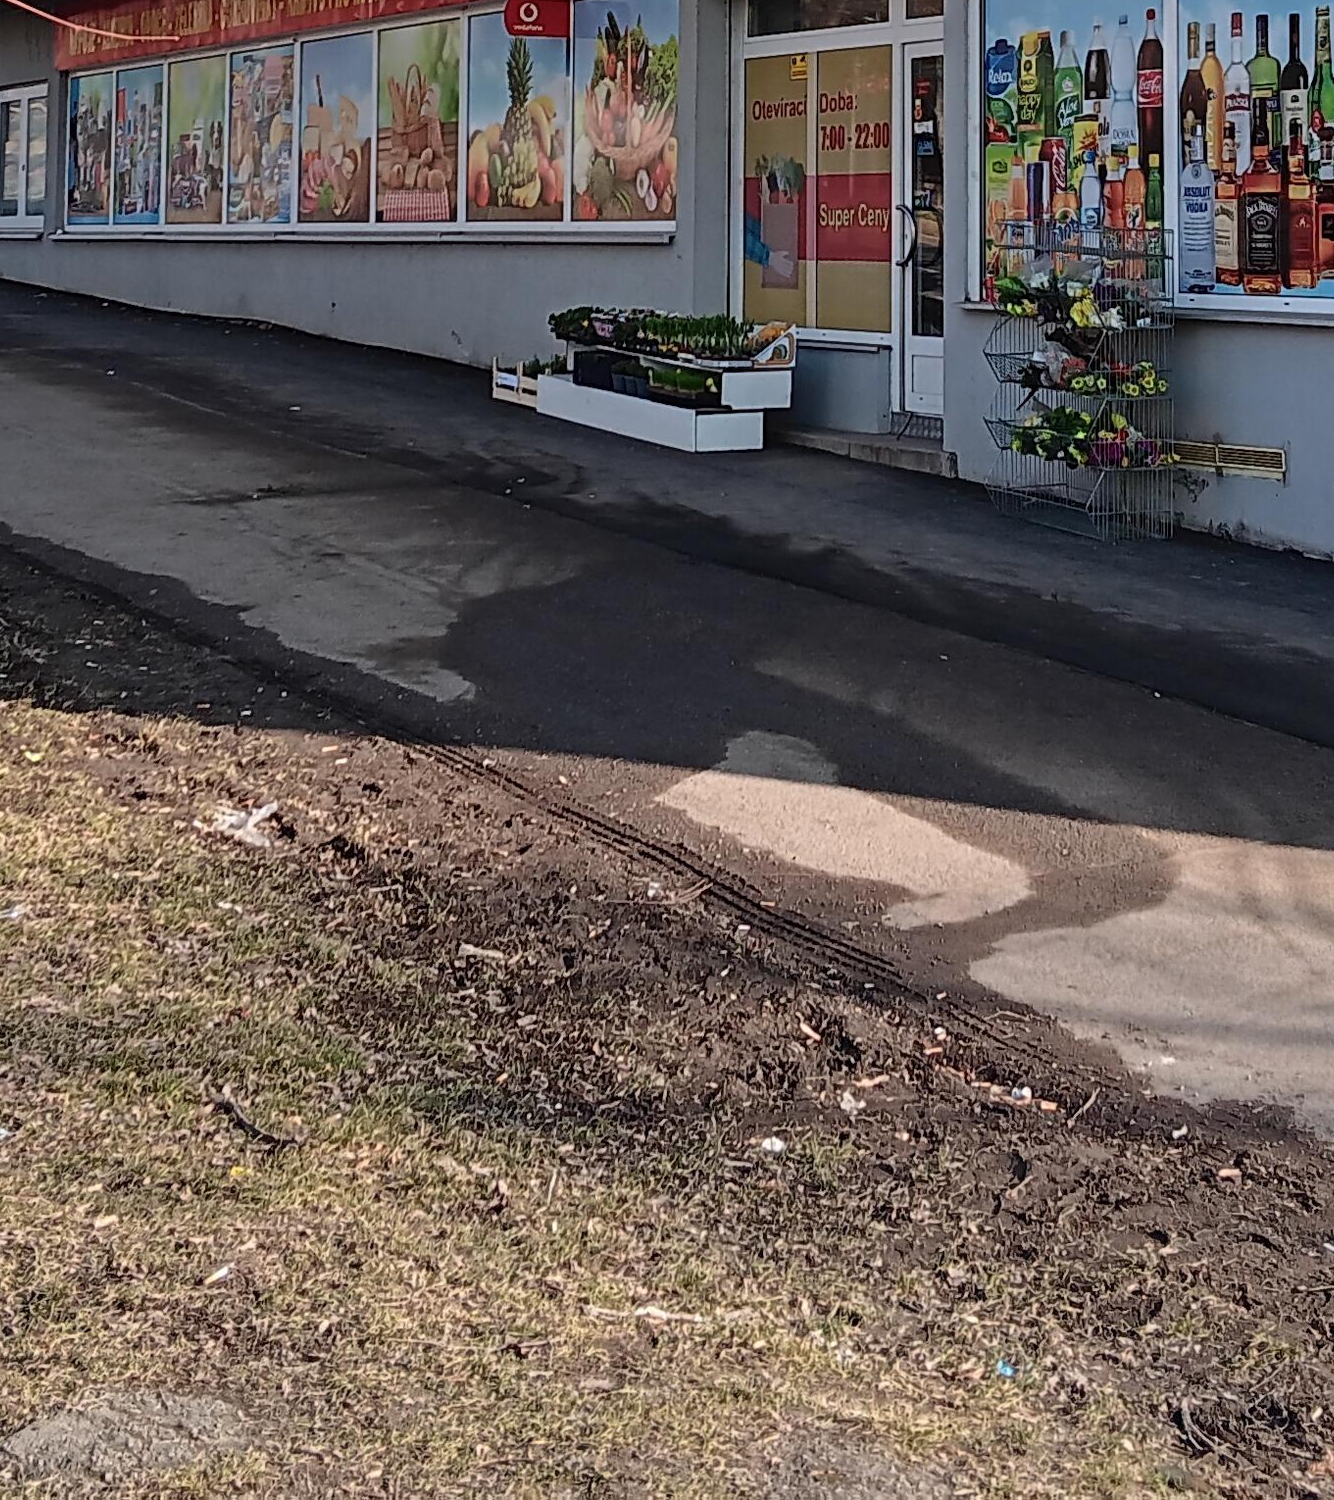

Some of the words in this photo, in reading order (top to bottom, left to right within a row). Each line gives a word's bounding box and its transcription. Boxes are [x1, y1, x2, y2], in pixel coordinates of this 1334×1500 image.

[988, 70, 1013, 84] Relax
[819, 91, 858, 113] Doba:
[1021, 106, 1037, 125] day
[820, 125, 845, 151] 7:00
[854, 122, 890, 149] 22:00
[1183, 185, 1211, 197] ABSOLUT
[819, 203, 855, 231] Super
[858, 202, 891, 233] Ceny
